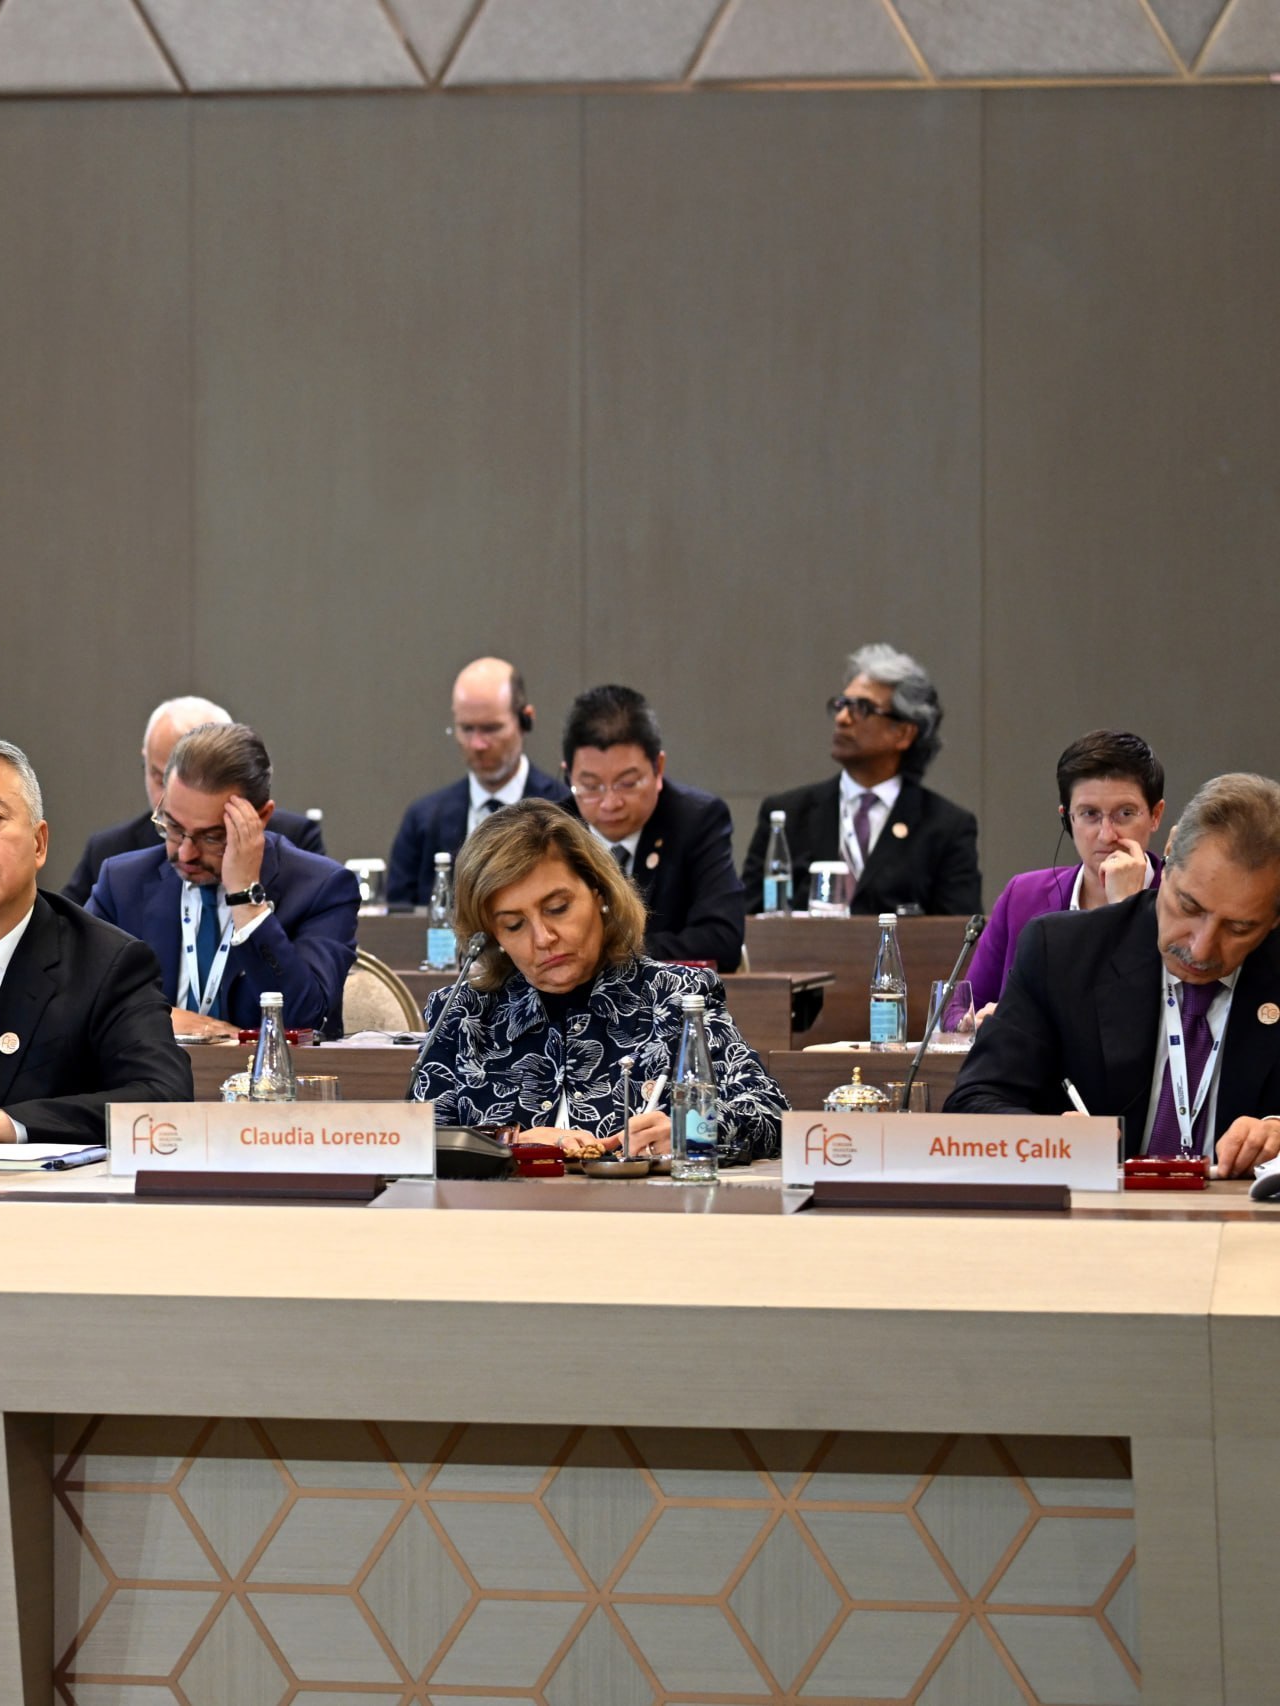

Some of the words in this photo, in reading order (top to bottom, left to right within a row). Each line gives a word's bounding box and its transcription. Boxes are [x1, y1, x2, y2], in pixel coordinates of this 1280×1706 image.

[239, 1127, 315, 1146] Claudia
[321, 1128, 401, 1146] Lorenzo
[928, 1136, 1009, 1158] Ahmet
[1015, 1138, 1072, 1163] Çalık
